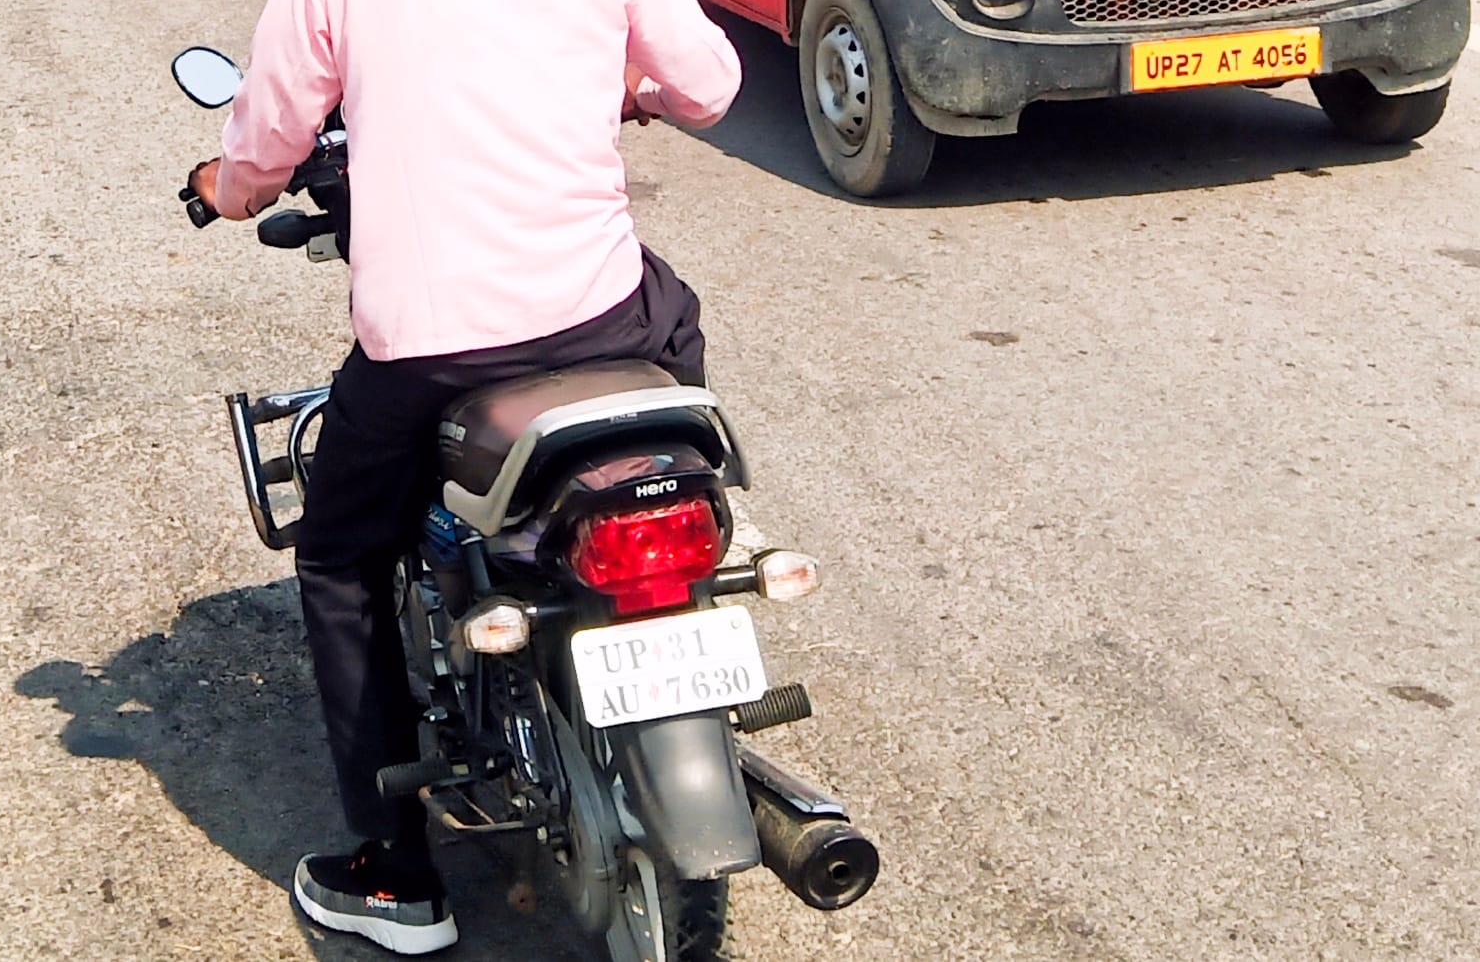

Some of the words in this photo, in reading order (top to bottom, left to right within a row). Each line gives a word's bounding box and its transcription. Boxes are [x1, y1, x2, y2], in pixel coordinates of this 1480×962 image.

[1146, 52, 1203, 79] UP27
[1217, 49, 1242, 74] AT
[1252, 43, 1307, 68] 4056
[598, 639, 647, 674] UP
[668, 628, 710, 661] 31
[600, 684, 640, 720] AU
[666, 665, 751, 705] 7630
